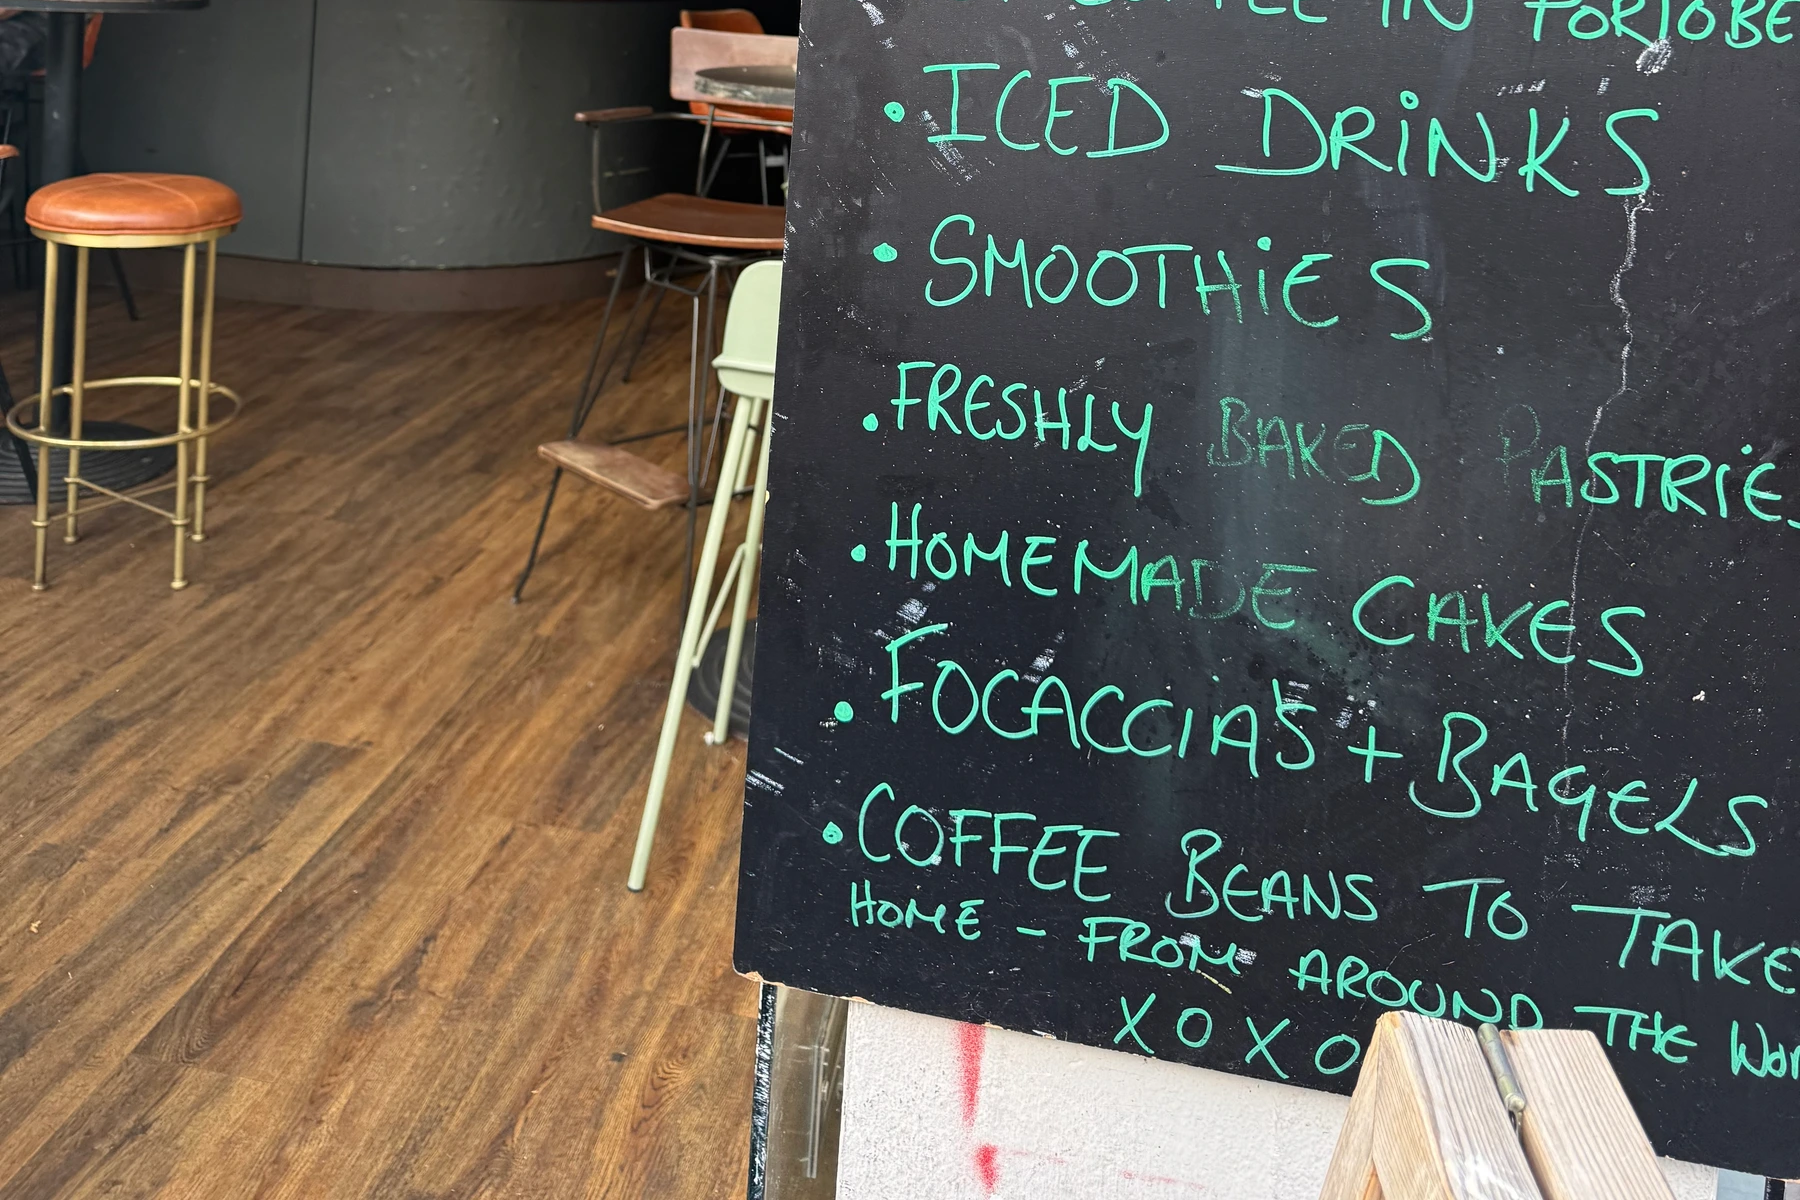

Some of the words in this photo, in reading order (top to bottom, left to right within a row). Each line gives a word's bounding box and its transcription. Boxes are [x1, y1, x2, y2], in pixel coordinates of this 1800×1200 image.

[923, 63, 1170, 158] ICED
[889, 360, 1154, 498] FRESHLY
[1208, 396, 1422, 506] BAKED
[884, 501, 1316, 631] HOMEMADE
[1352, 574, 1646, 678] CAKES
[1347, 725, 1403, 784] +
[1408, 711, 1768, 857] BAGELS
[857, 781, 1118, 903] COFFEE
[1165, 828, 1378, 923] BEANS
[1422, 878, 1529, 941] TO
[1570, 904, 1800, 995] TAKE
[850, 879, 985, 941] HOME
[1077, 916, 1242, 976] FROM
[1287, 949, 1544, 1031] AROUND
[1573, 1005, 1699, 1064] THE
